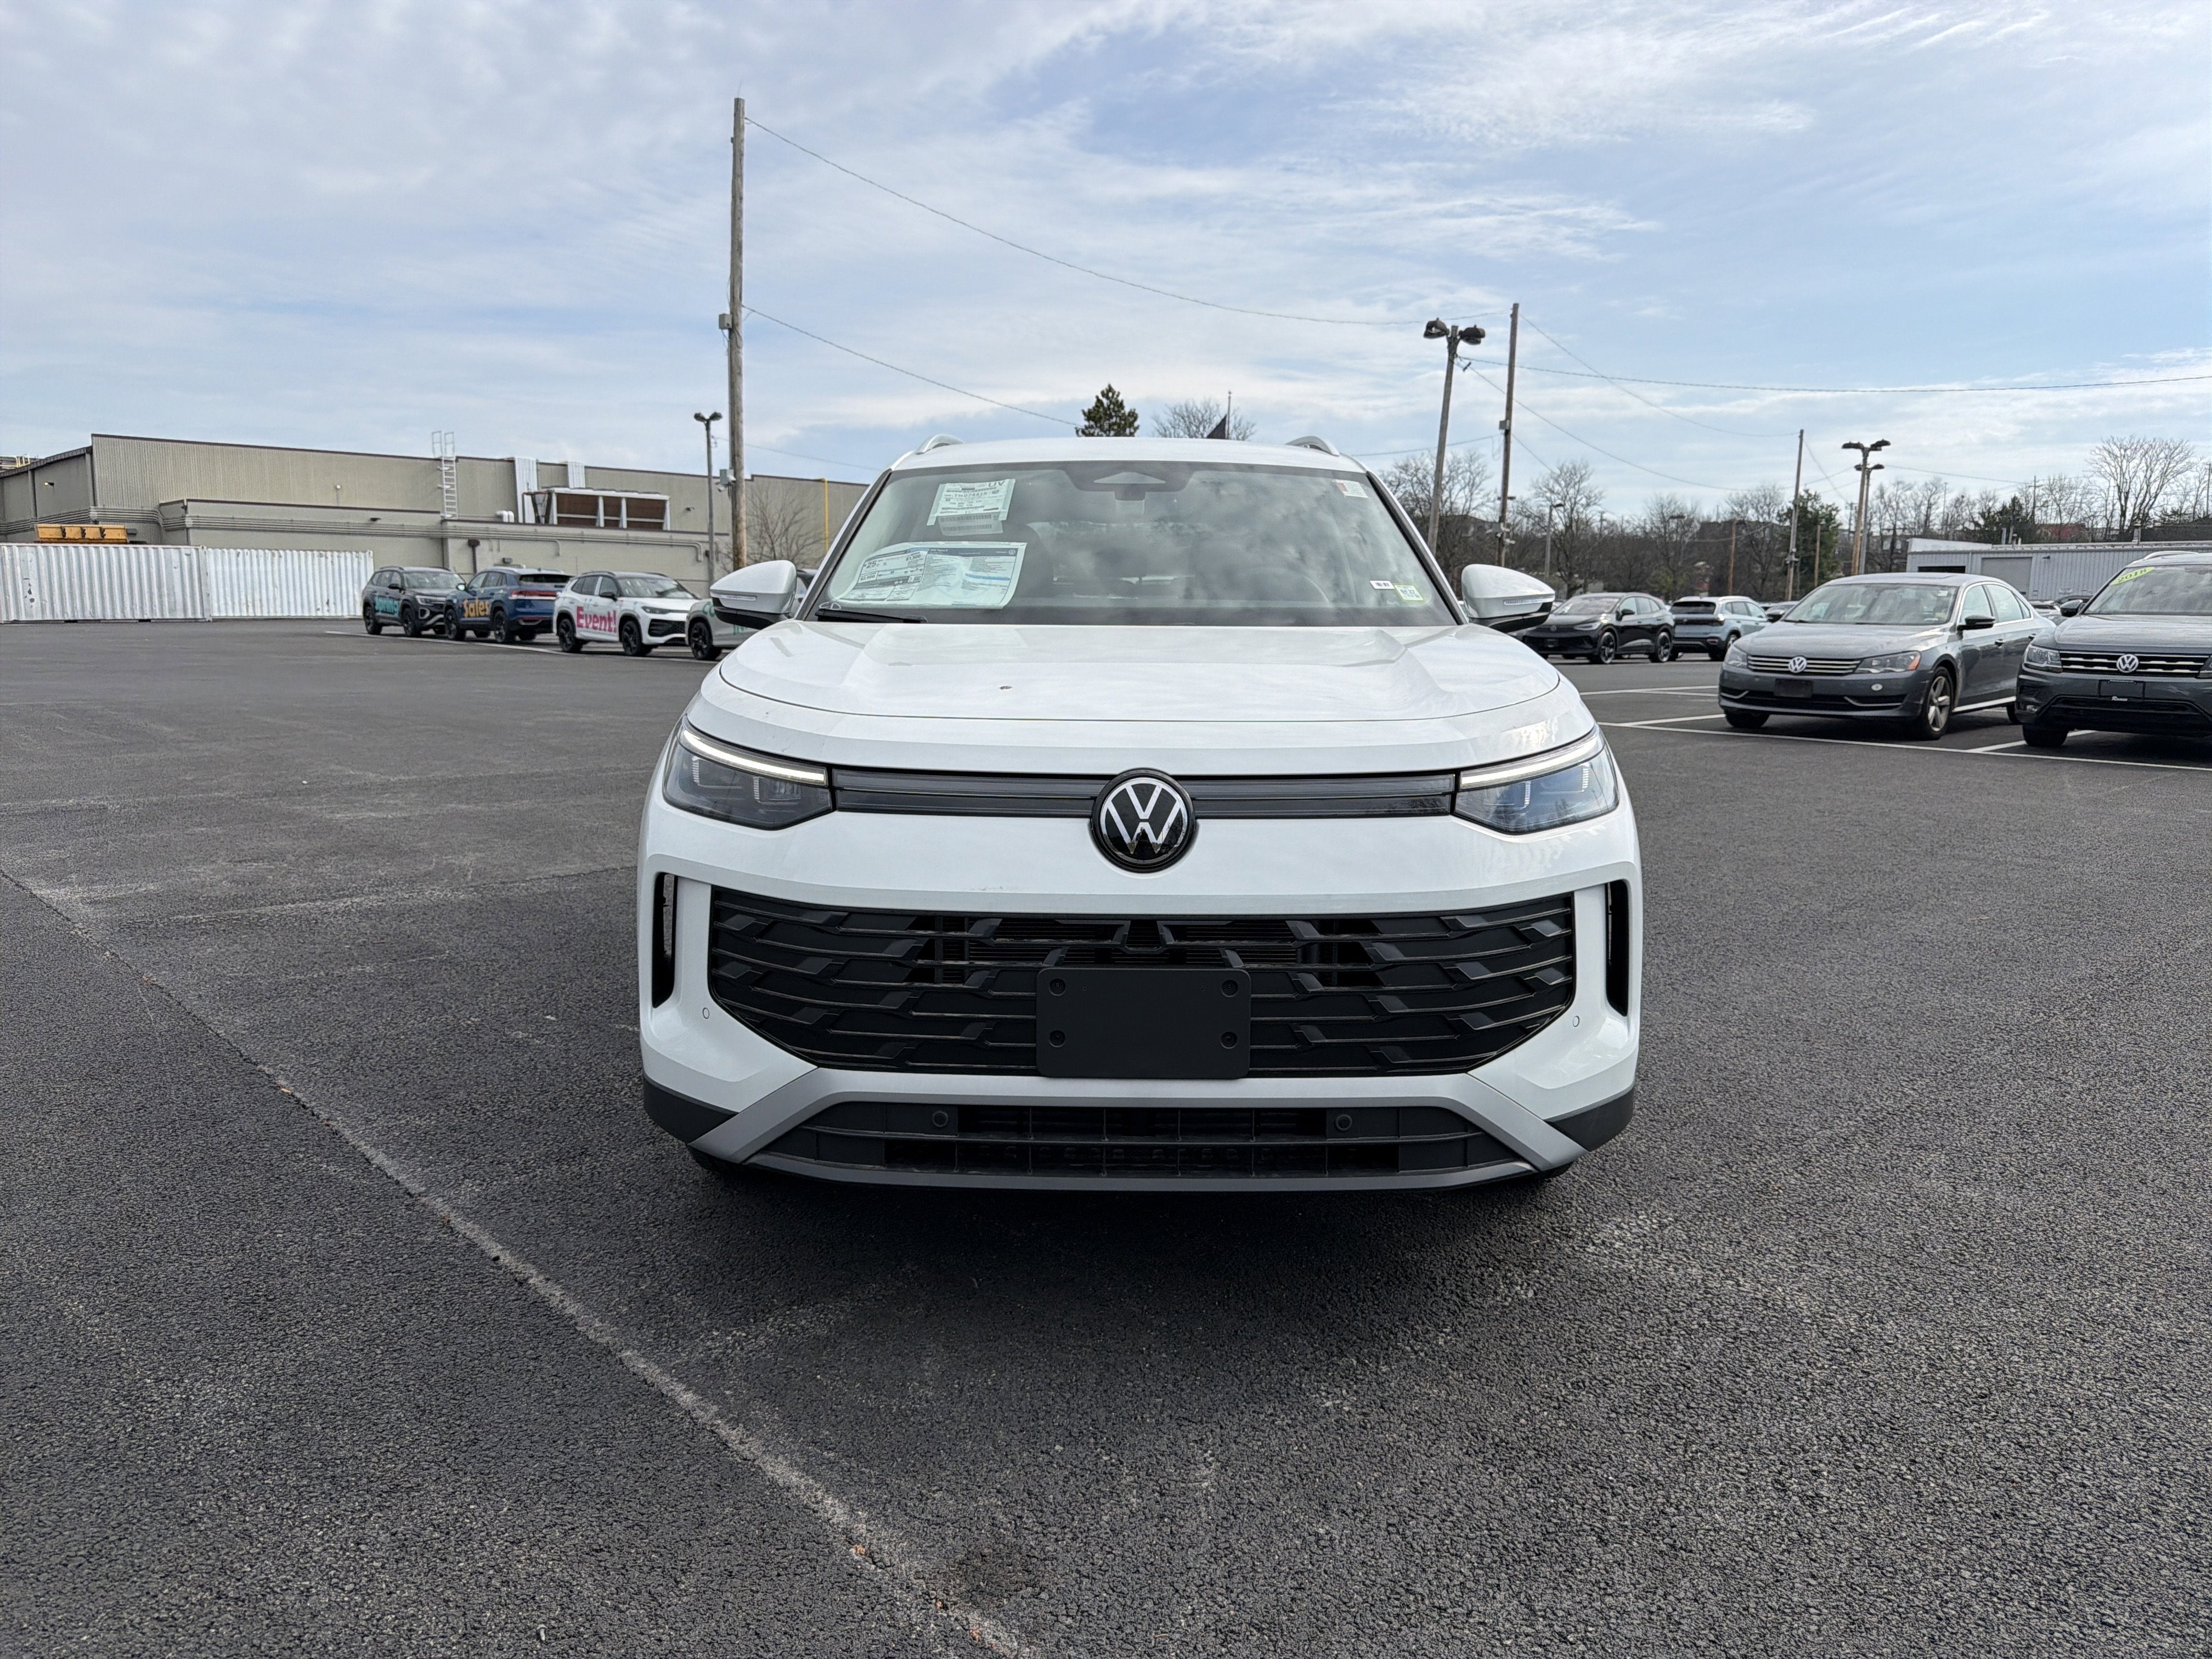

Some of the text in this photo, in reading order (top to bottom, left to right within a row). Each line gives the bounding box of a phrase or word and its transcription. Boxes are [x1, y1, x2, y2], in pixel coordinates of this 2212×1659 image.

[866, 561, 877, 569] 25
[2118, 568, 2147, 583] 2018
[463, 596, 490, 618] Sales
[577, 606, 617, 633] Event!
